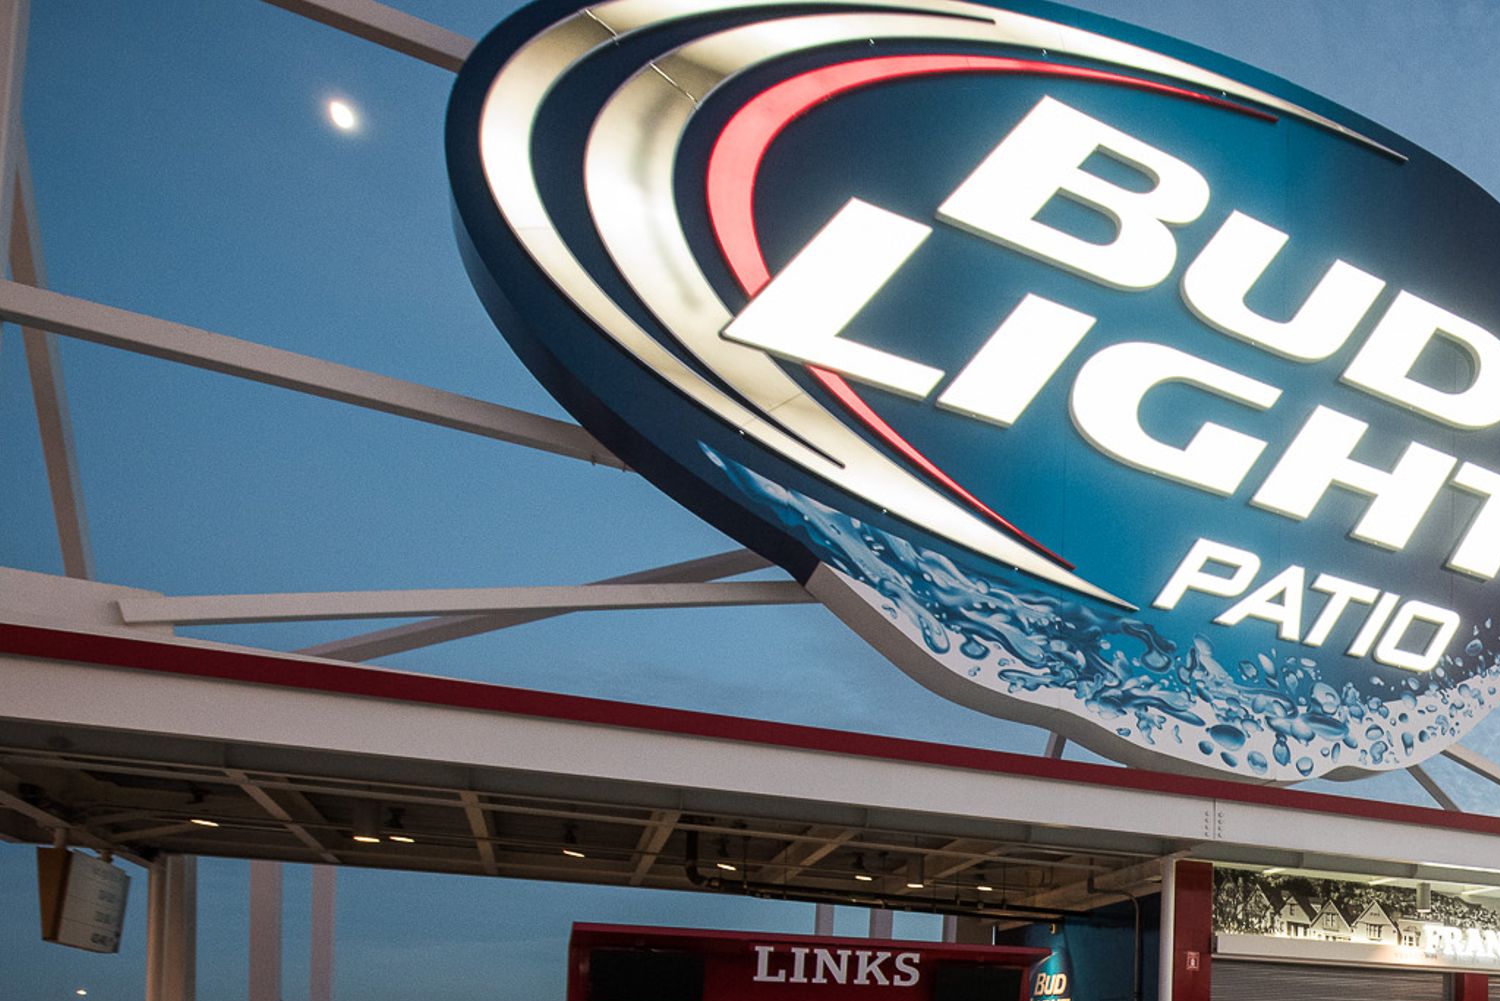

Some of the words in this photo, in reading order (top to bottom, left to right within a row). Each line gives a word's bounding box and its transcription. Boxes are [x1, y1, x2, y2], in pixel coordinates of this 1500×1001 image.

[1153, 538, 1461, 673] PATIO
[753, 945, 921, 987] LINKS
[1033, 972, 1067, 996] BUD
